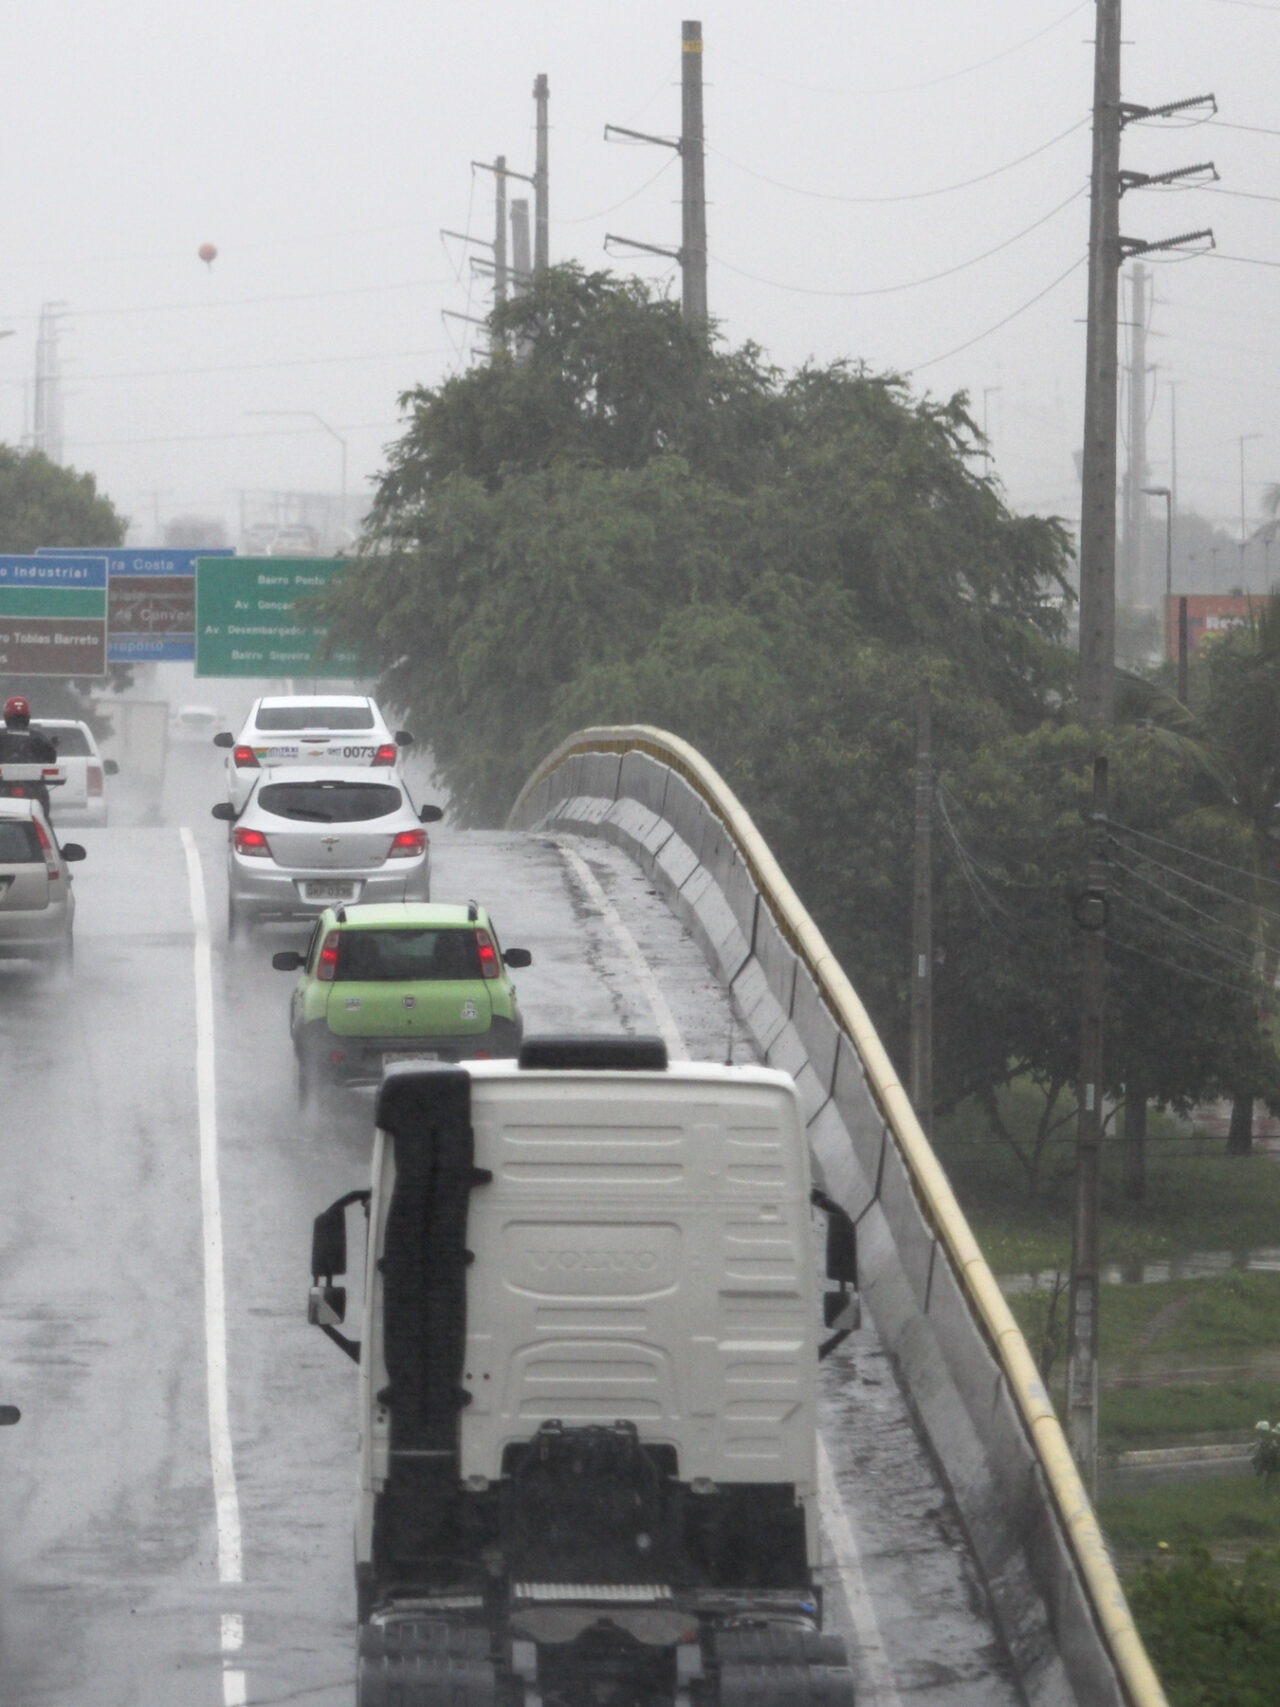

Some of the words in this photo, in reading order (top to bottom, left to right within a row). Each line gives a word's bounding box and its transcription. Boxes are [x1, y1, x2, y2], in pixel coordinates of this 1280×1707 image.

[133, 558, 174, 570] Costa
[14, 565, 87, 579] Industrial
[257, 575, 289, 585] Bairro
[295, 575, 325, 585] Ponto
[234, 600, 249, 609] Av
[205, 625, 220, 635] Av
[227, 625, 308, 638] Desembargador
[14, 632, 51, 645] Tobias
[54, 633, 99, 645] Barreto
[231, 650, 263, 660] Bairro
[269, 650, 311, 662] Siqueira
[343, 746, 375, 758] 0073
[524, 1250, 658, 1271] VOLVO
